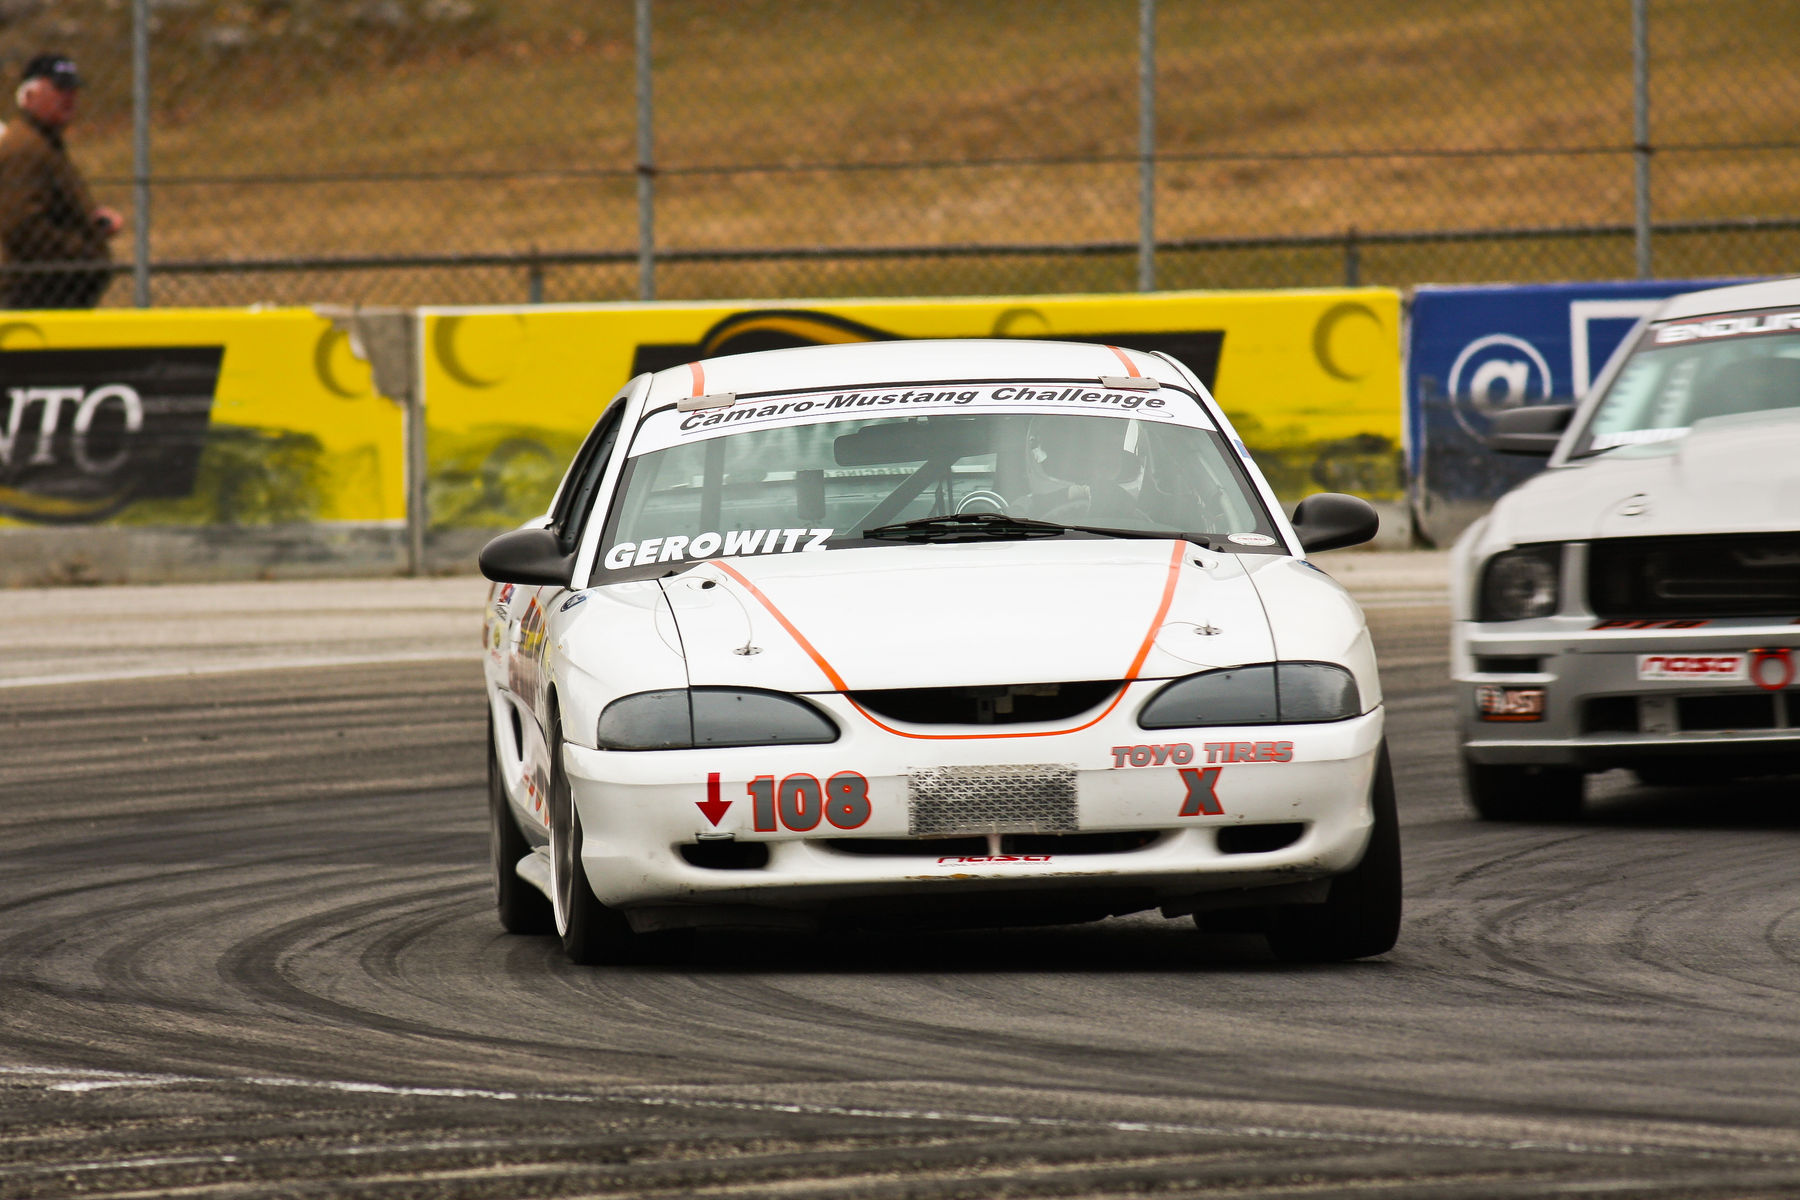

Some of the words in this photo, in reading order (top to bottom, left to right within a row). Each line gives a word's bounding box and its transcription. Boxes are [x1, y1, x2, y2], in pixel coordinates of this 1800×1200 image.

[679, 389, 979, 431] Camaro-Mustang
[991, 387, 1166, 409] Challenge
[604, 528, 834, 570] GEROWITZ
[1112, 743, 1194, 768] TOYO
[1204, 741, 1294, 763] TIRES
[747, 770, 871, 832] 108
[1177, 767, 1225, 817] X
